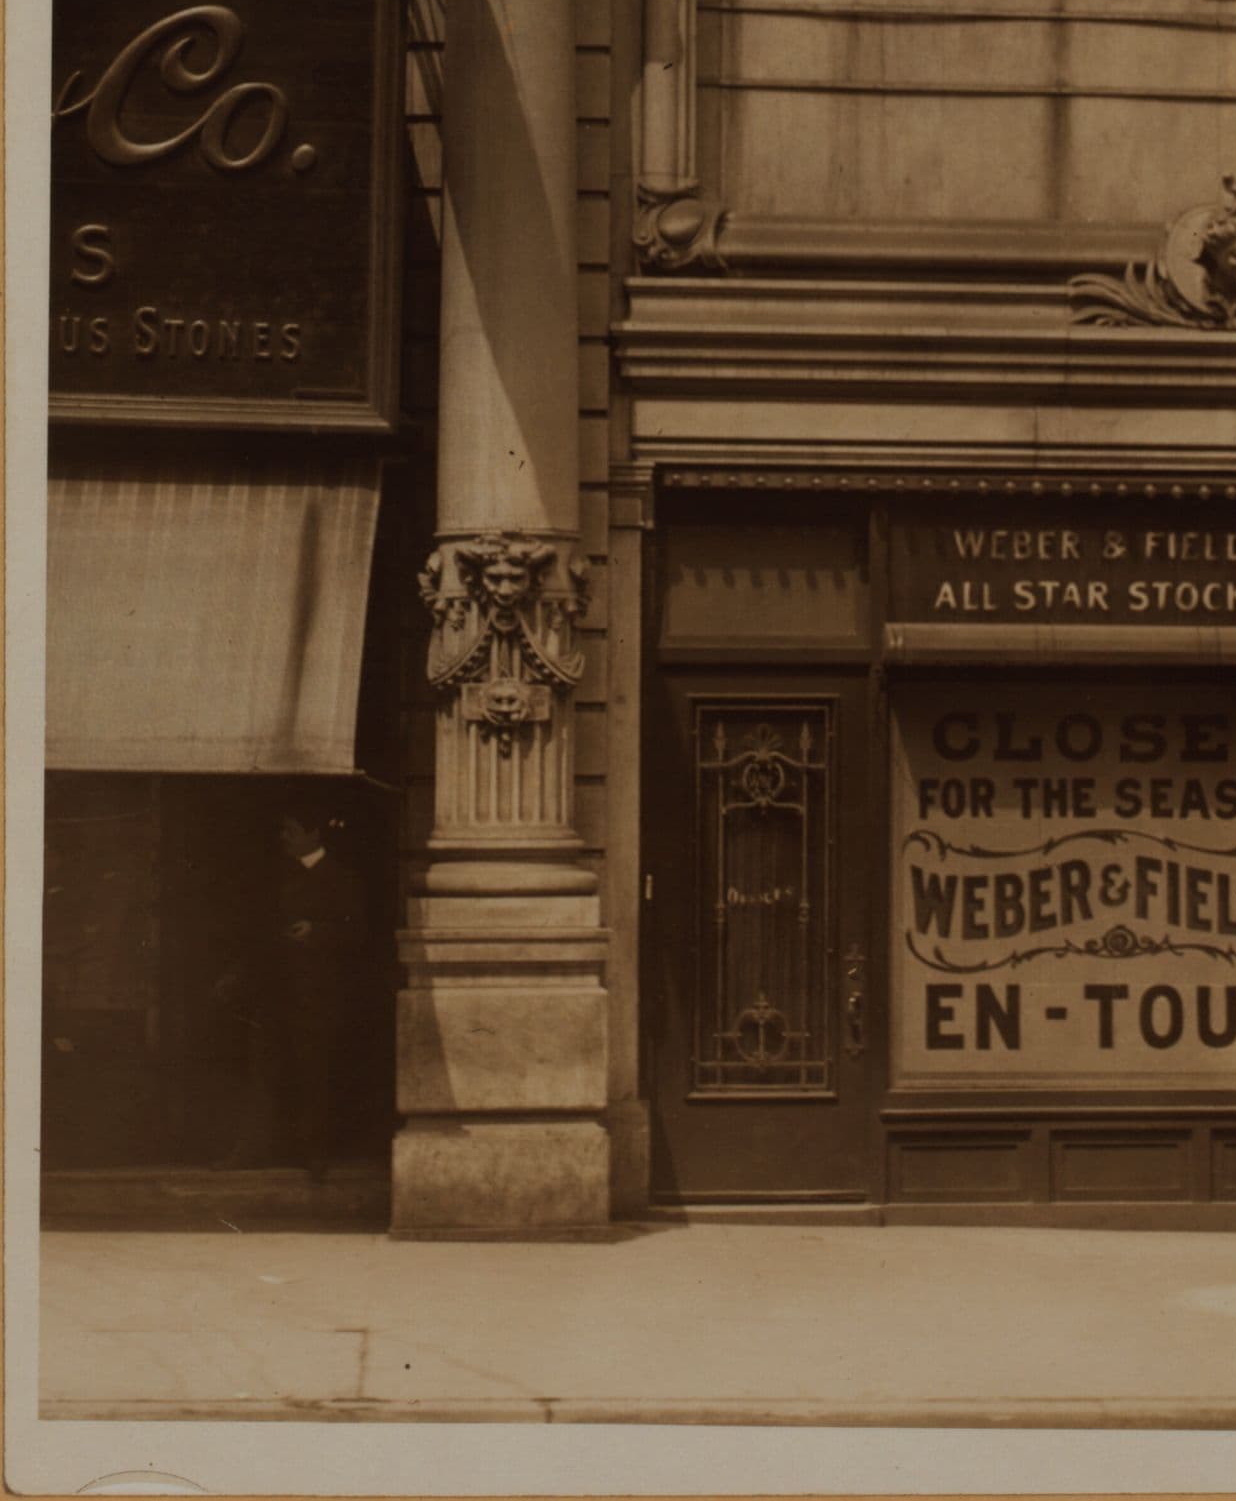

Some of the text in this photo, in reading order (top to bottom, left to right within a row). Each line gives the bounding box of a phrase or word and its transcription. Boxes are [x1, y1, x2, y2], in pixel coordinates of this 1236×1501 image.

[86, 2, 318, 172] Co.
[953, 530, 1081, 560] WEBER
[1102, 529, 1127, 560] &
[934, 581, 998, 610] ALL
[1013, 581, 1109, 610] STAR
[918, 778, 996, 820] FOR
[1012, 777, 1097, 818] THE
[909, 859, 1094, 941] WEBER
[1099, 864, 1133, 908] &
